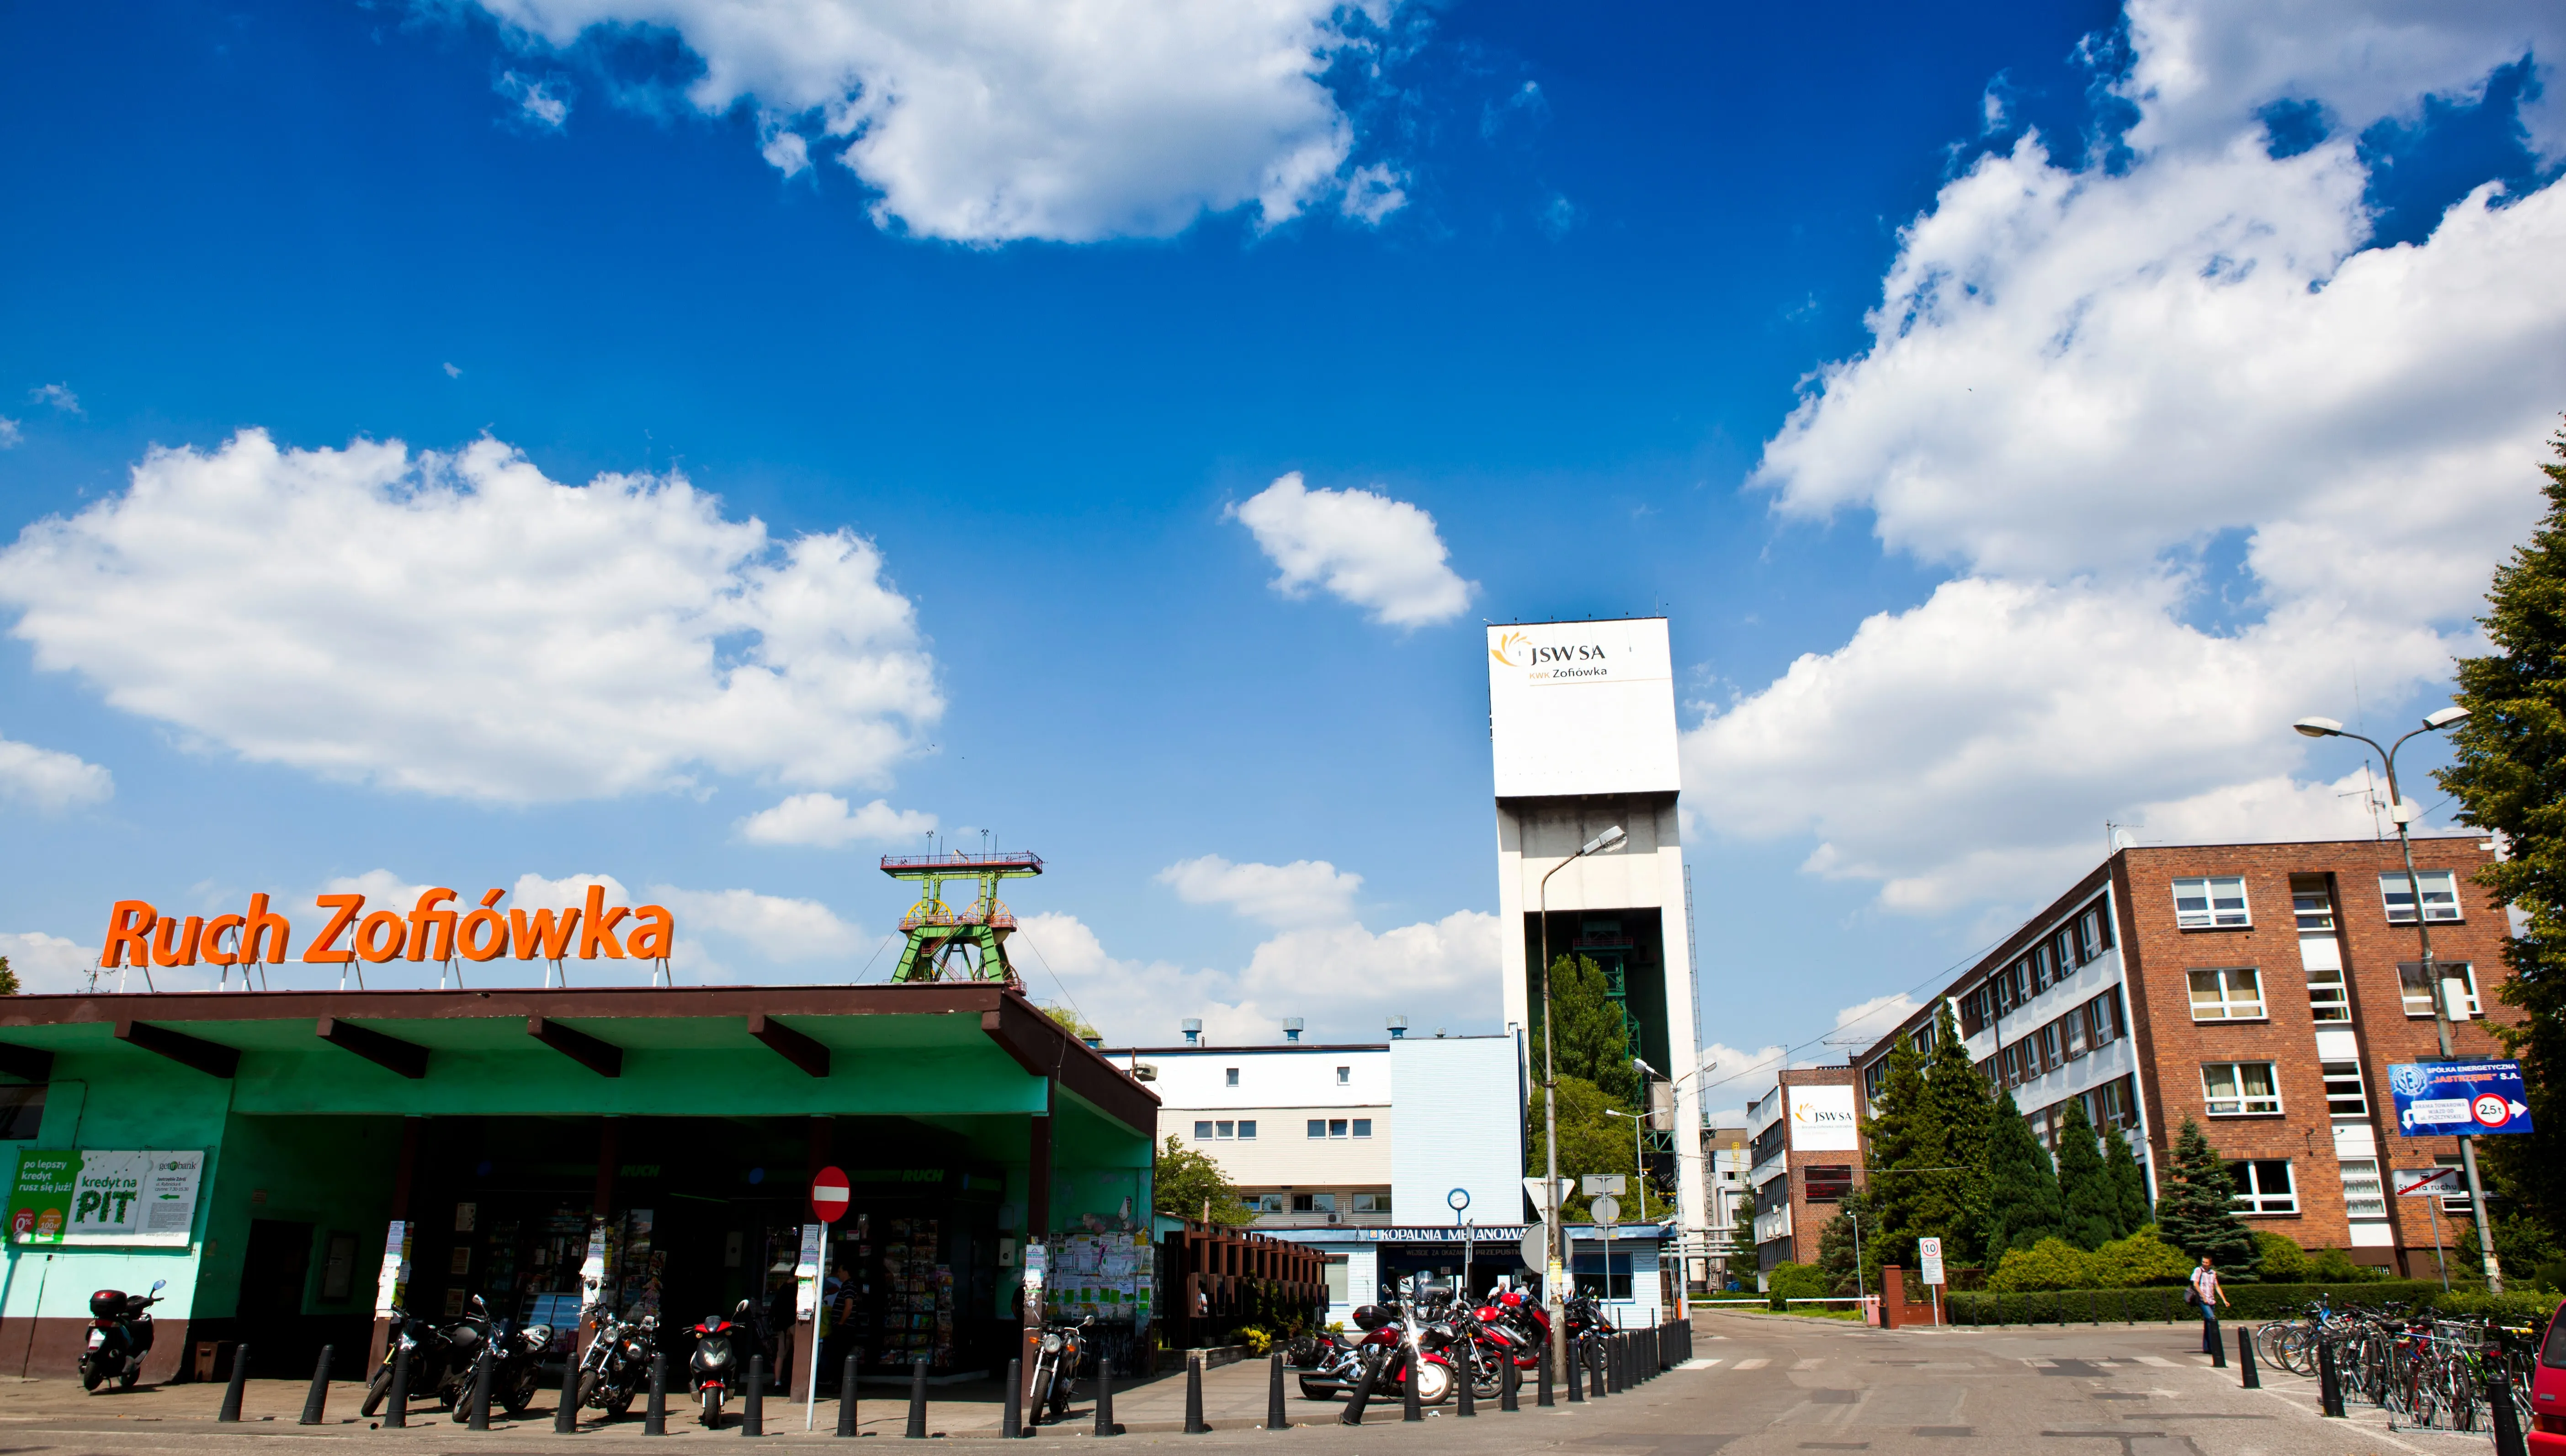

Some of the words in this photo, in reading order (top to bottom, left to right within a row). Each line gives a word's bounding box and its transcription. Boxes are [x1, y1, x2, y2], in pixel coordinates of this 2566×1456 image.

[1531, 646, 1575, 666] JSW
[1579, 645, 1605, 660] SA
[1553, 667, 1607, 678] Zofiówka
[101, 892, 290, 968] Ruch
[303, 885, 674, 965] Zofiówka
[2457, 1064, 2517, 1072] ENERGETYCZNA
[1815, 1112, 1837, 1123] JSW
[1839, 1112, 1852, 1121] SA
[24, 1161, 36, 1170] po
[37, 1159, 67, 1170] lepszy
[21, 1171, 52, 1182] kredyt
[620, 1164, 660, 1178] RUCH
[902, 1168, 945, 1182] RUCH
[40, 1182, 53, 1193] się
[53, 1182, 72, 1193] już!
[81, 1175, 122, 1190] kredyt
[122, 1179, 137, 1188] na
[74, 1190, 137, 1224] PIT
[1381, 1229, 1442, 1240] KOPALNIA
[1925, 1244, 1936, 1252] 10
